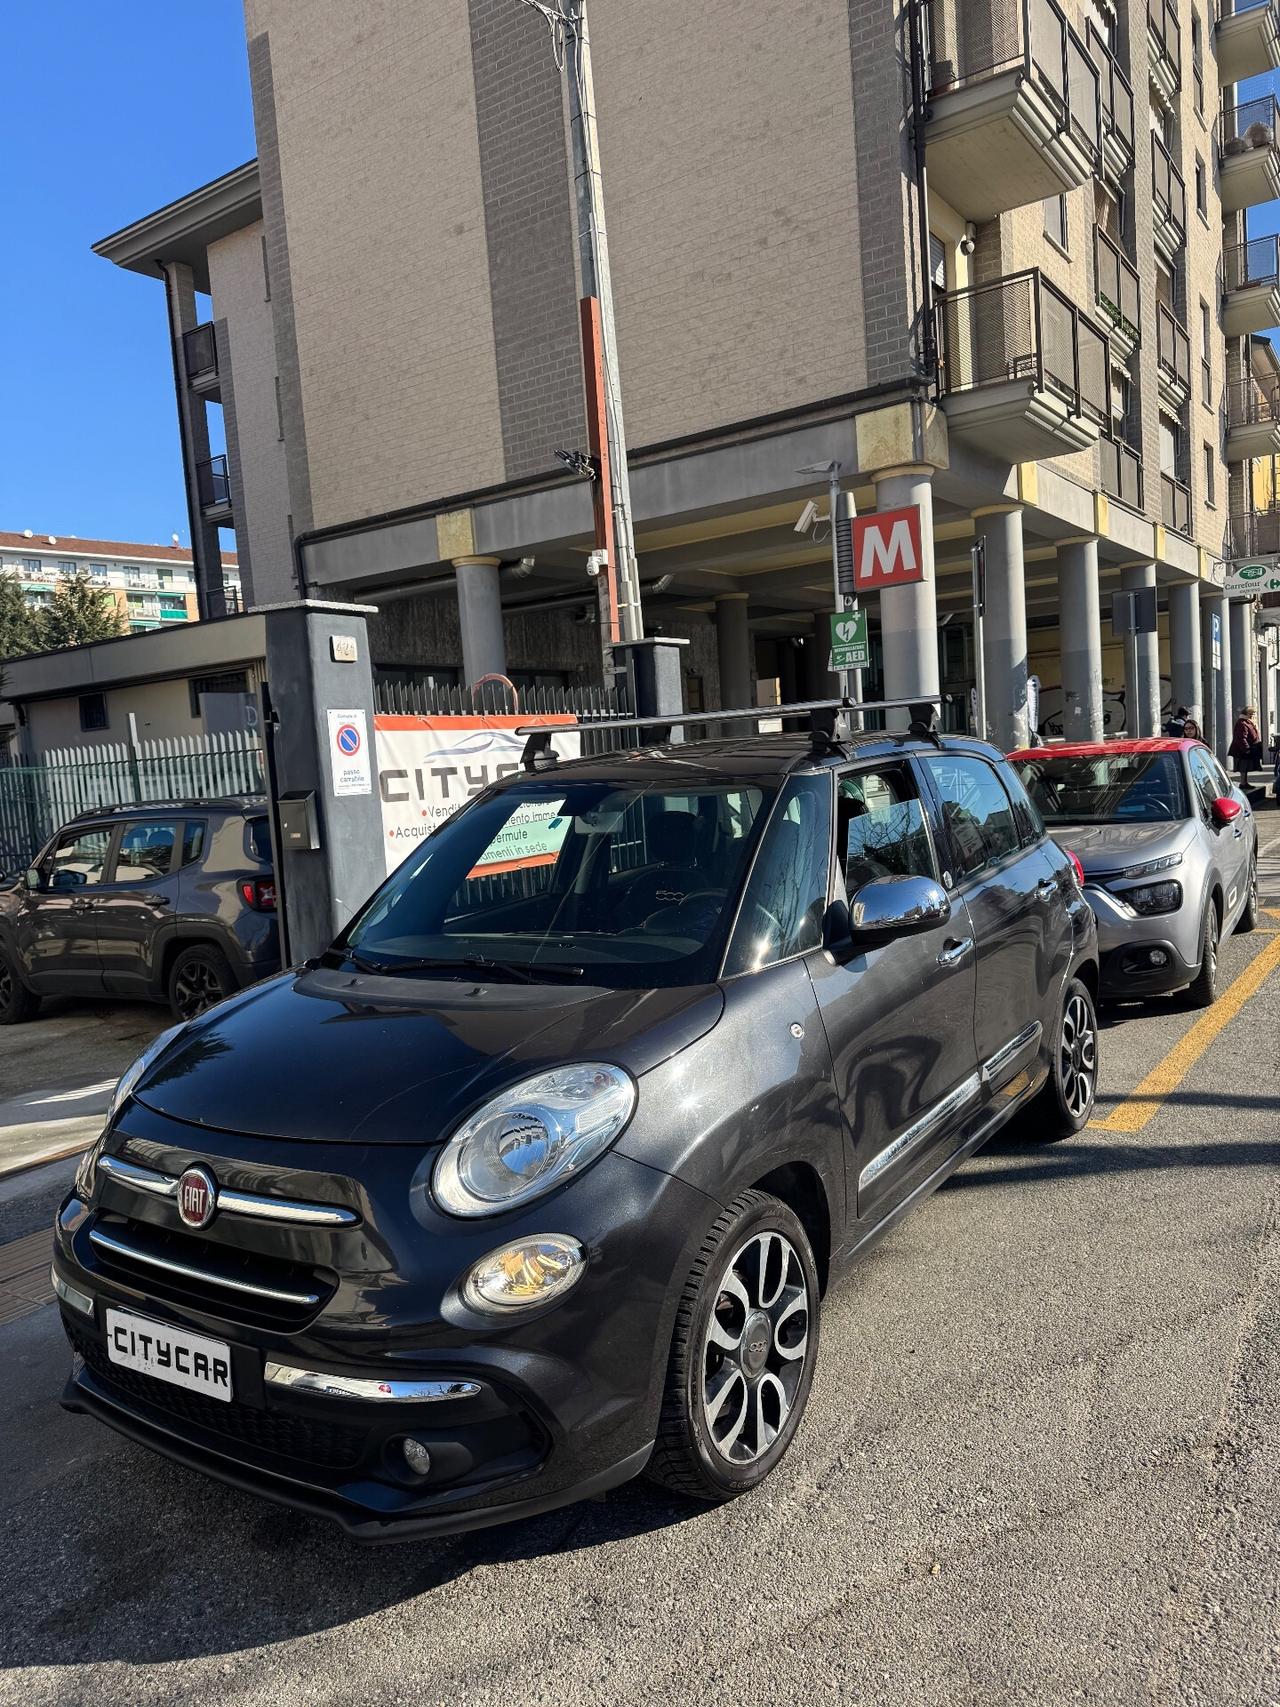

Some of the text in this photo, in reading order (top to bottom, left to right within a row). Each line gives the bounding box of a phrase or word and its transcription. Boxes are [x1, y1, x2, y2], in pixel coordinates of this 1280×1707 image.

[860, 519, 916, 578] M
[1225, 581, 1260, 590] Carrefour
[1212, 618, 1219, 640] P
[845, 650, 865, 662] AED
[514, 844, 525, 855] in
[525, 842, 548, 853] sede
[184, 1185, 206, 1214] FIAT
[114, 1326, 228, 1388] CITYCAR
